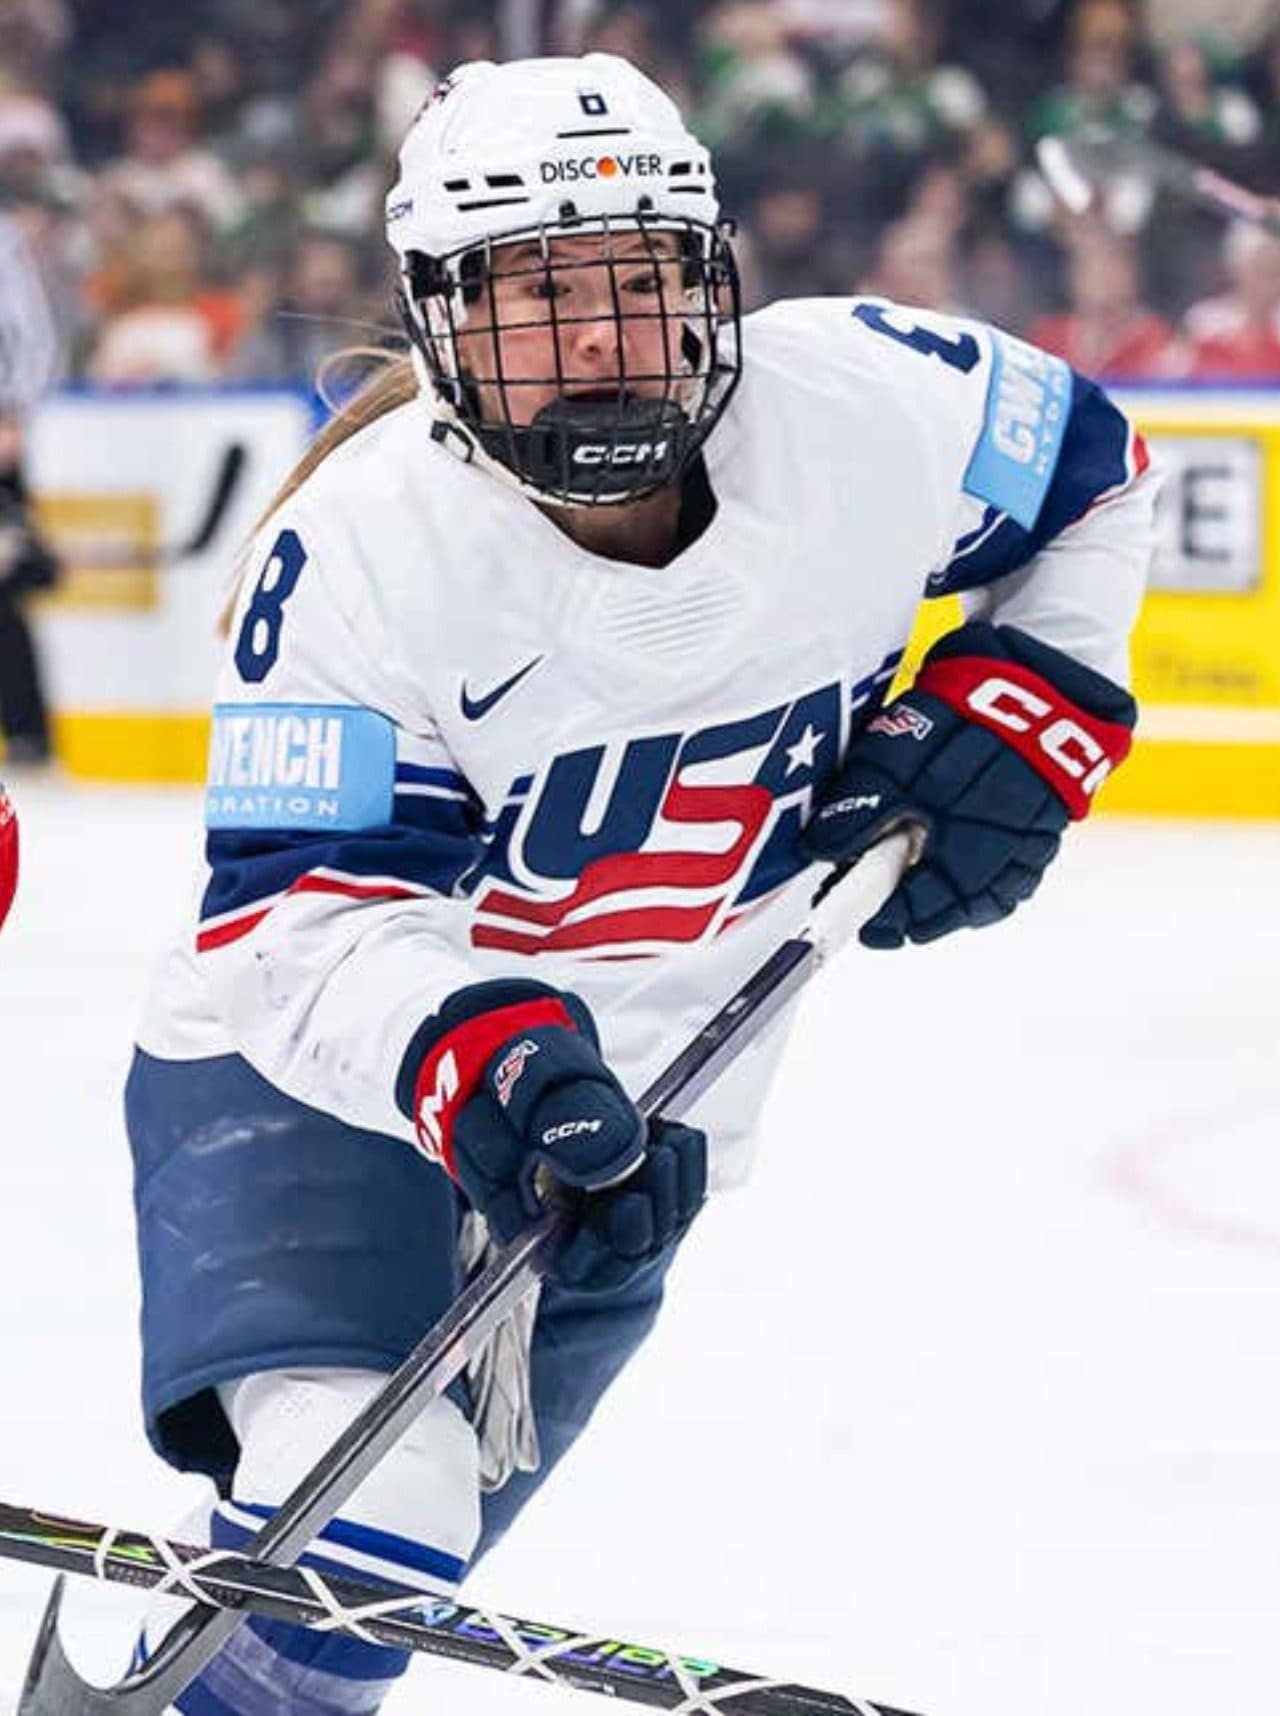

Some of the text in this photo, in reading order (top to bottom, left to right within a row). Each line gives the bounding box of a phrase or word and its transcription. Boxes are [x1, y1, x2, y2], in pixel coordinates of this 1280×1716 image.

[540, 153, 664, 183] DISCOVER
[573, 441, 668, 464] CCM
[234, 529, 308, 684] 8
[502, 682, 844, 915] USA
[542, 1119, 603, 1145] CCM
